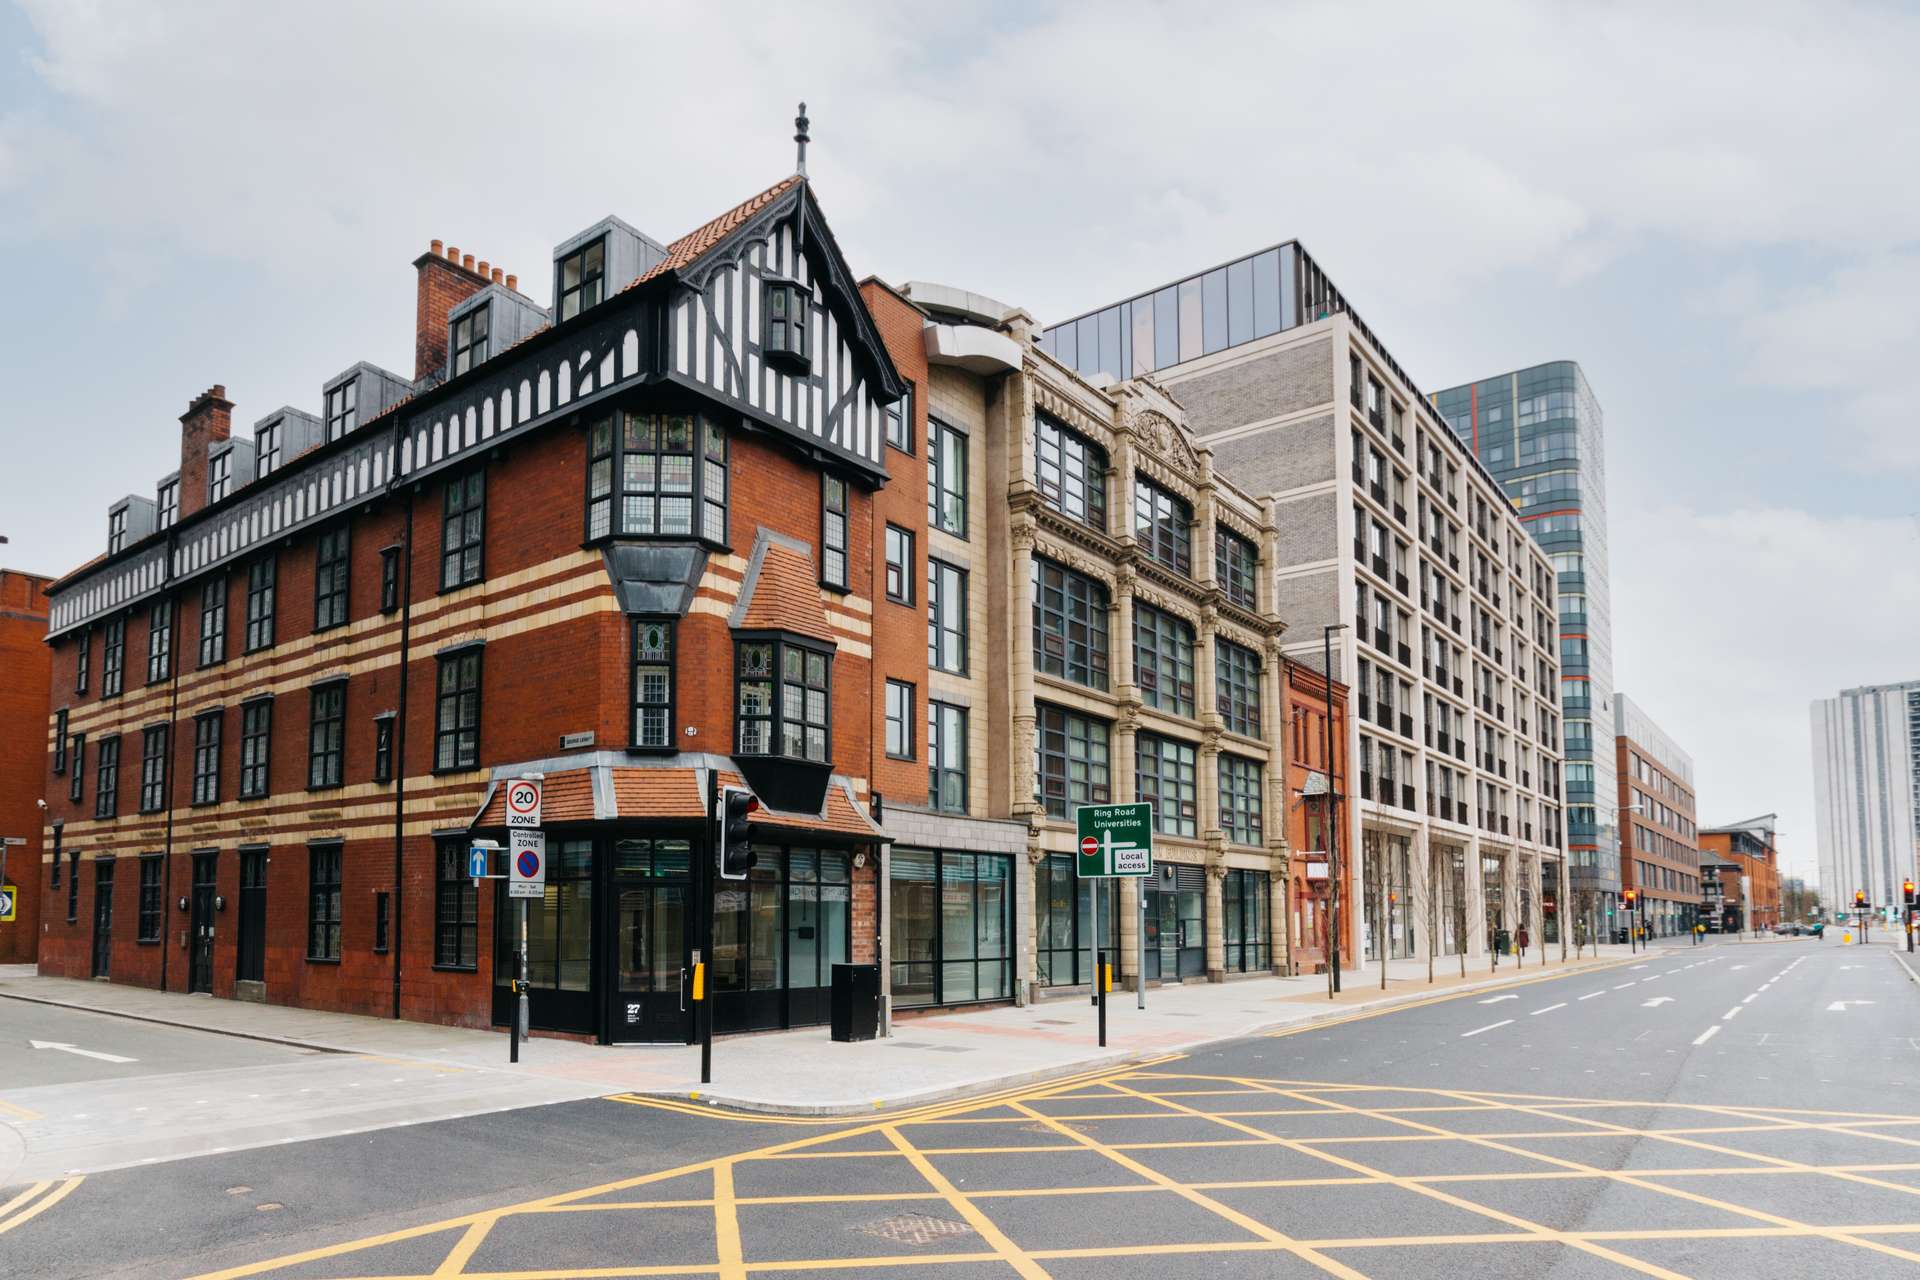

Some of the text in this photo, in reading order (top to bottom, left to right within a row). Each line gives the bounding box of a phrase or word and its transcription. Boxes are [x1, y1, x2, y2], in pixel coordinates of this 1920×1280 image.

[515, 791, 534, 804] 20
[1094, 808, 1136, 818] Ring Road
[511, 815, 536, 824] ZONE
[1094, 819, 1142, 828] Universities
[512, 831, 544, 839] Controlled
[517, 840, 539, 848] ZONE
[1120, 852, 1143, 860] Local
[627, 1003, 640, 1014] 27
